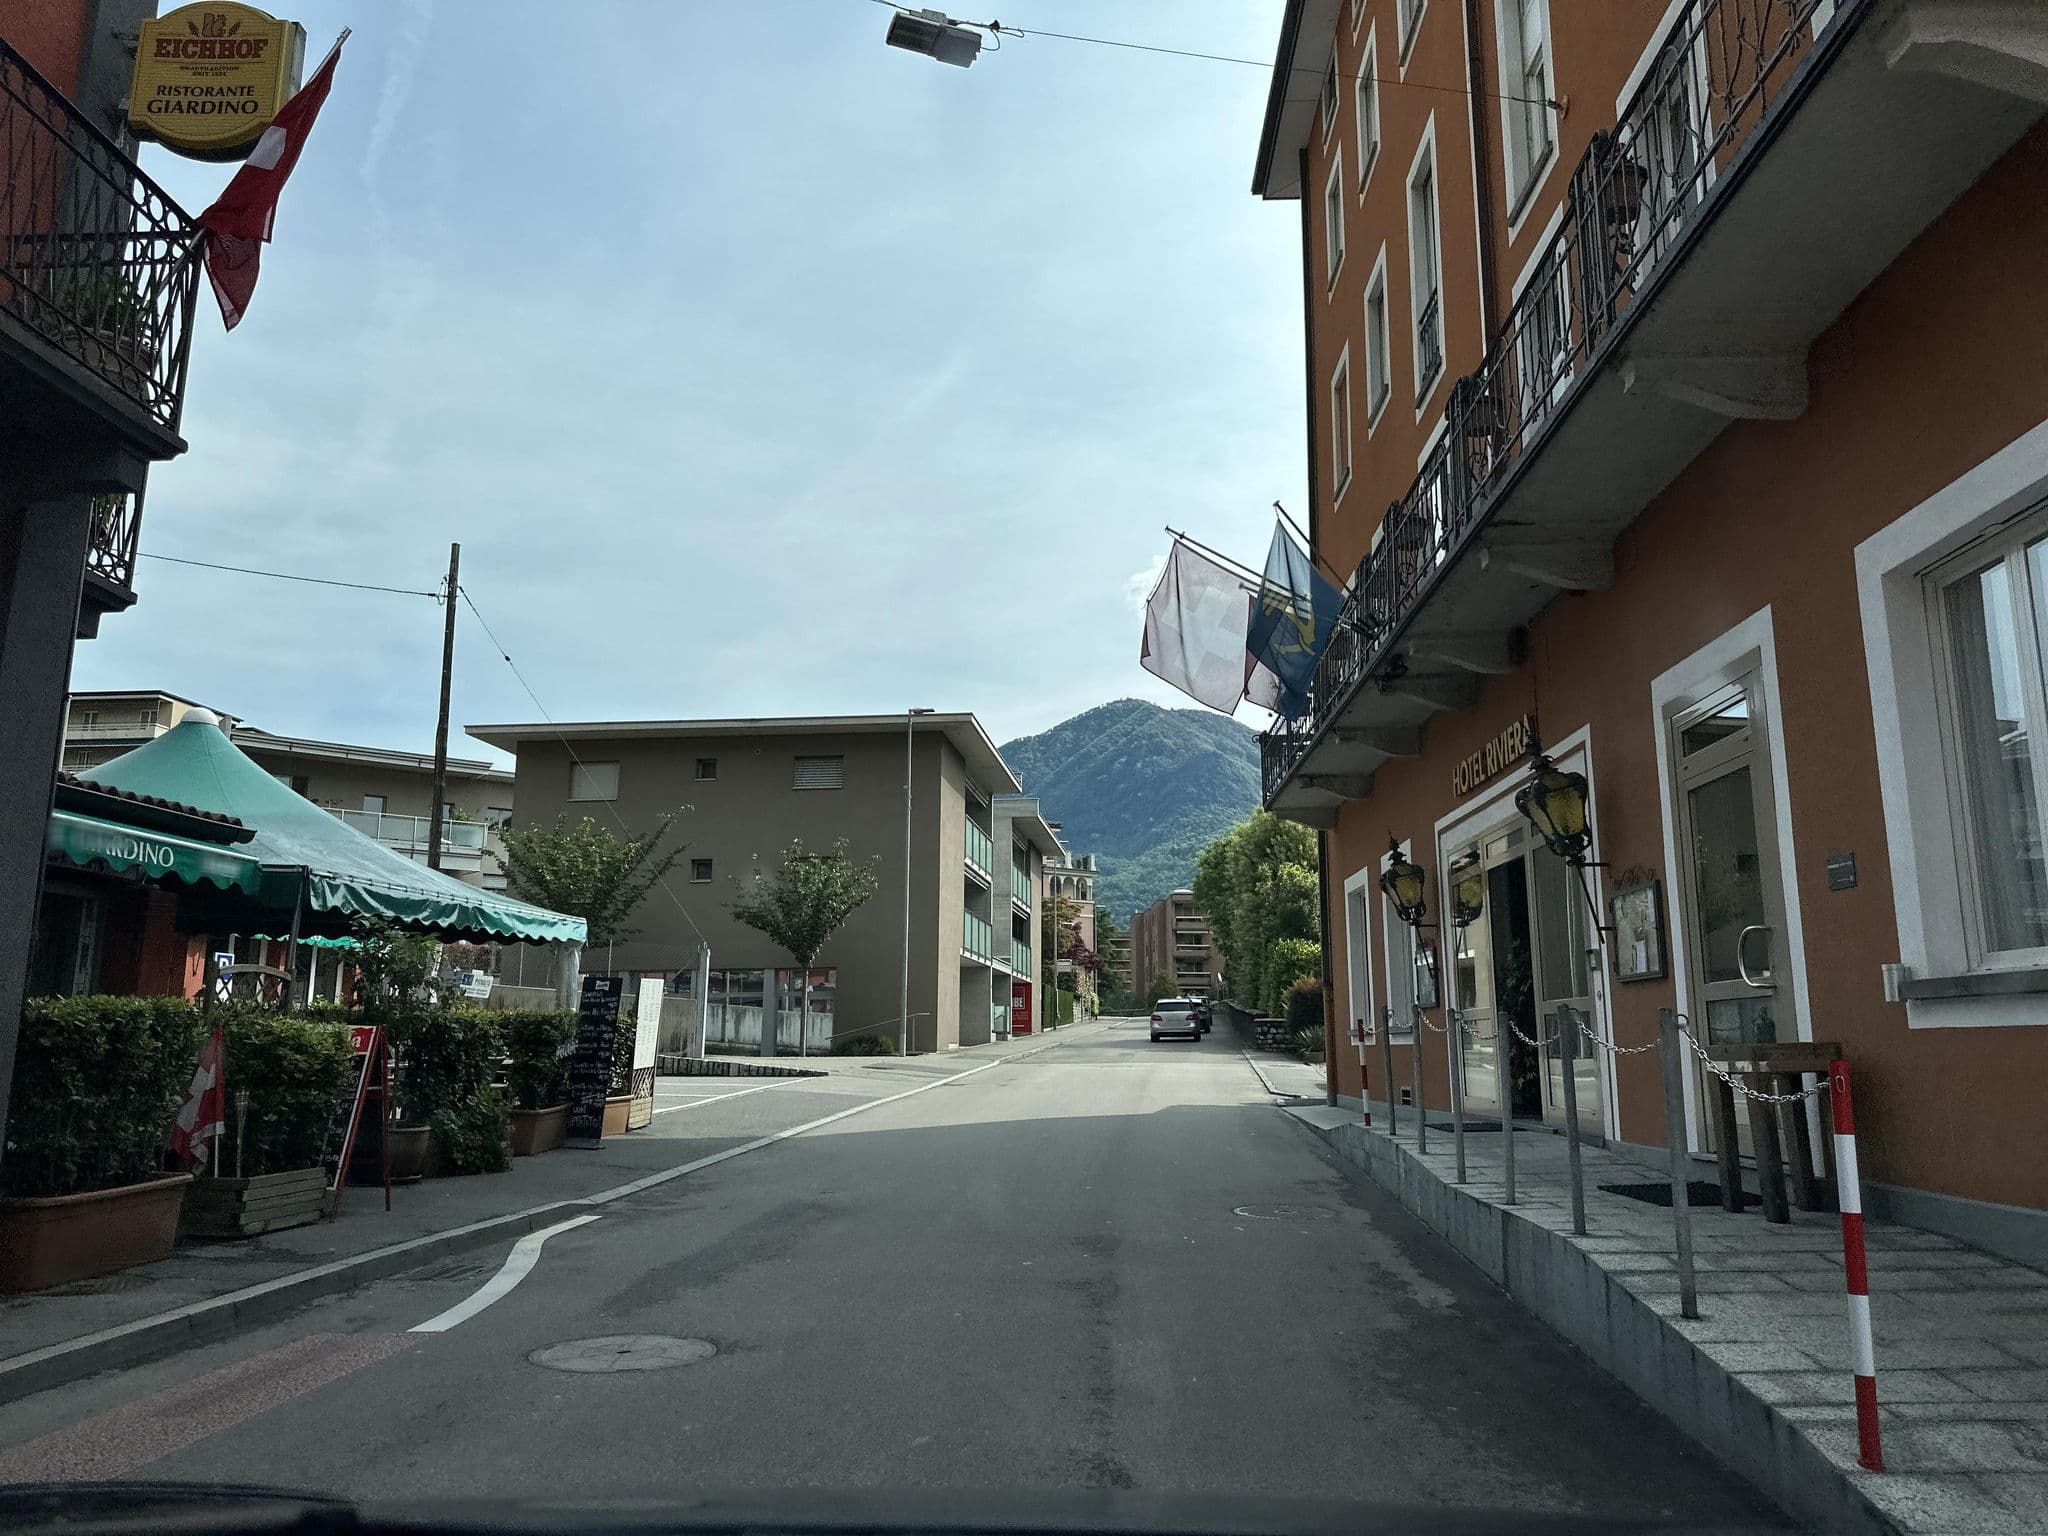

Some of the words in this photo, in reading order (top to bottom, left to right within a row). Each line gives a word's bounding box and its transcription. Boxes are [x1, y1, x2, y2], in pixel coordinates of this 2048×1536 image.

[153, 37, 269, 60] EICHHOF
[155, 85, 256, 97] RISTORANTE
[146, 99, 259, 115] GIARDINO
[1452, 749, 1485, 799] HOTEL
[1485, 713, 1530, 777] RIVIERA
